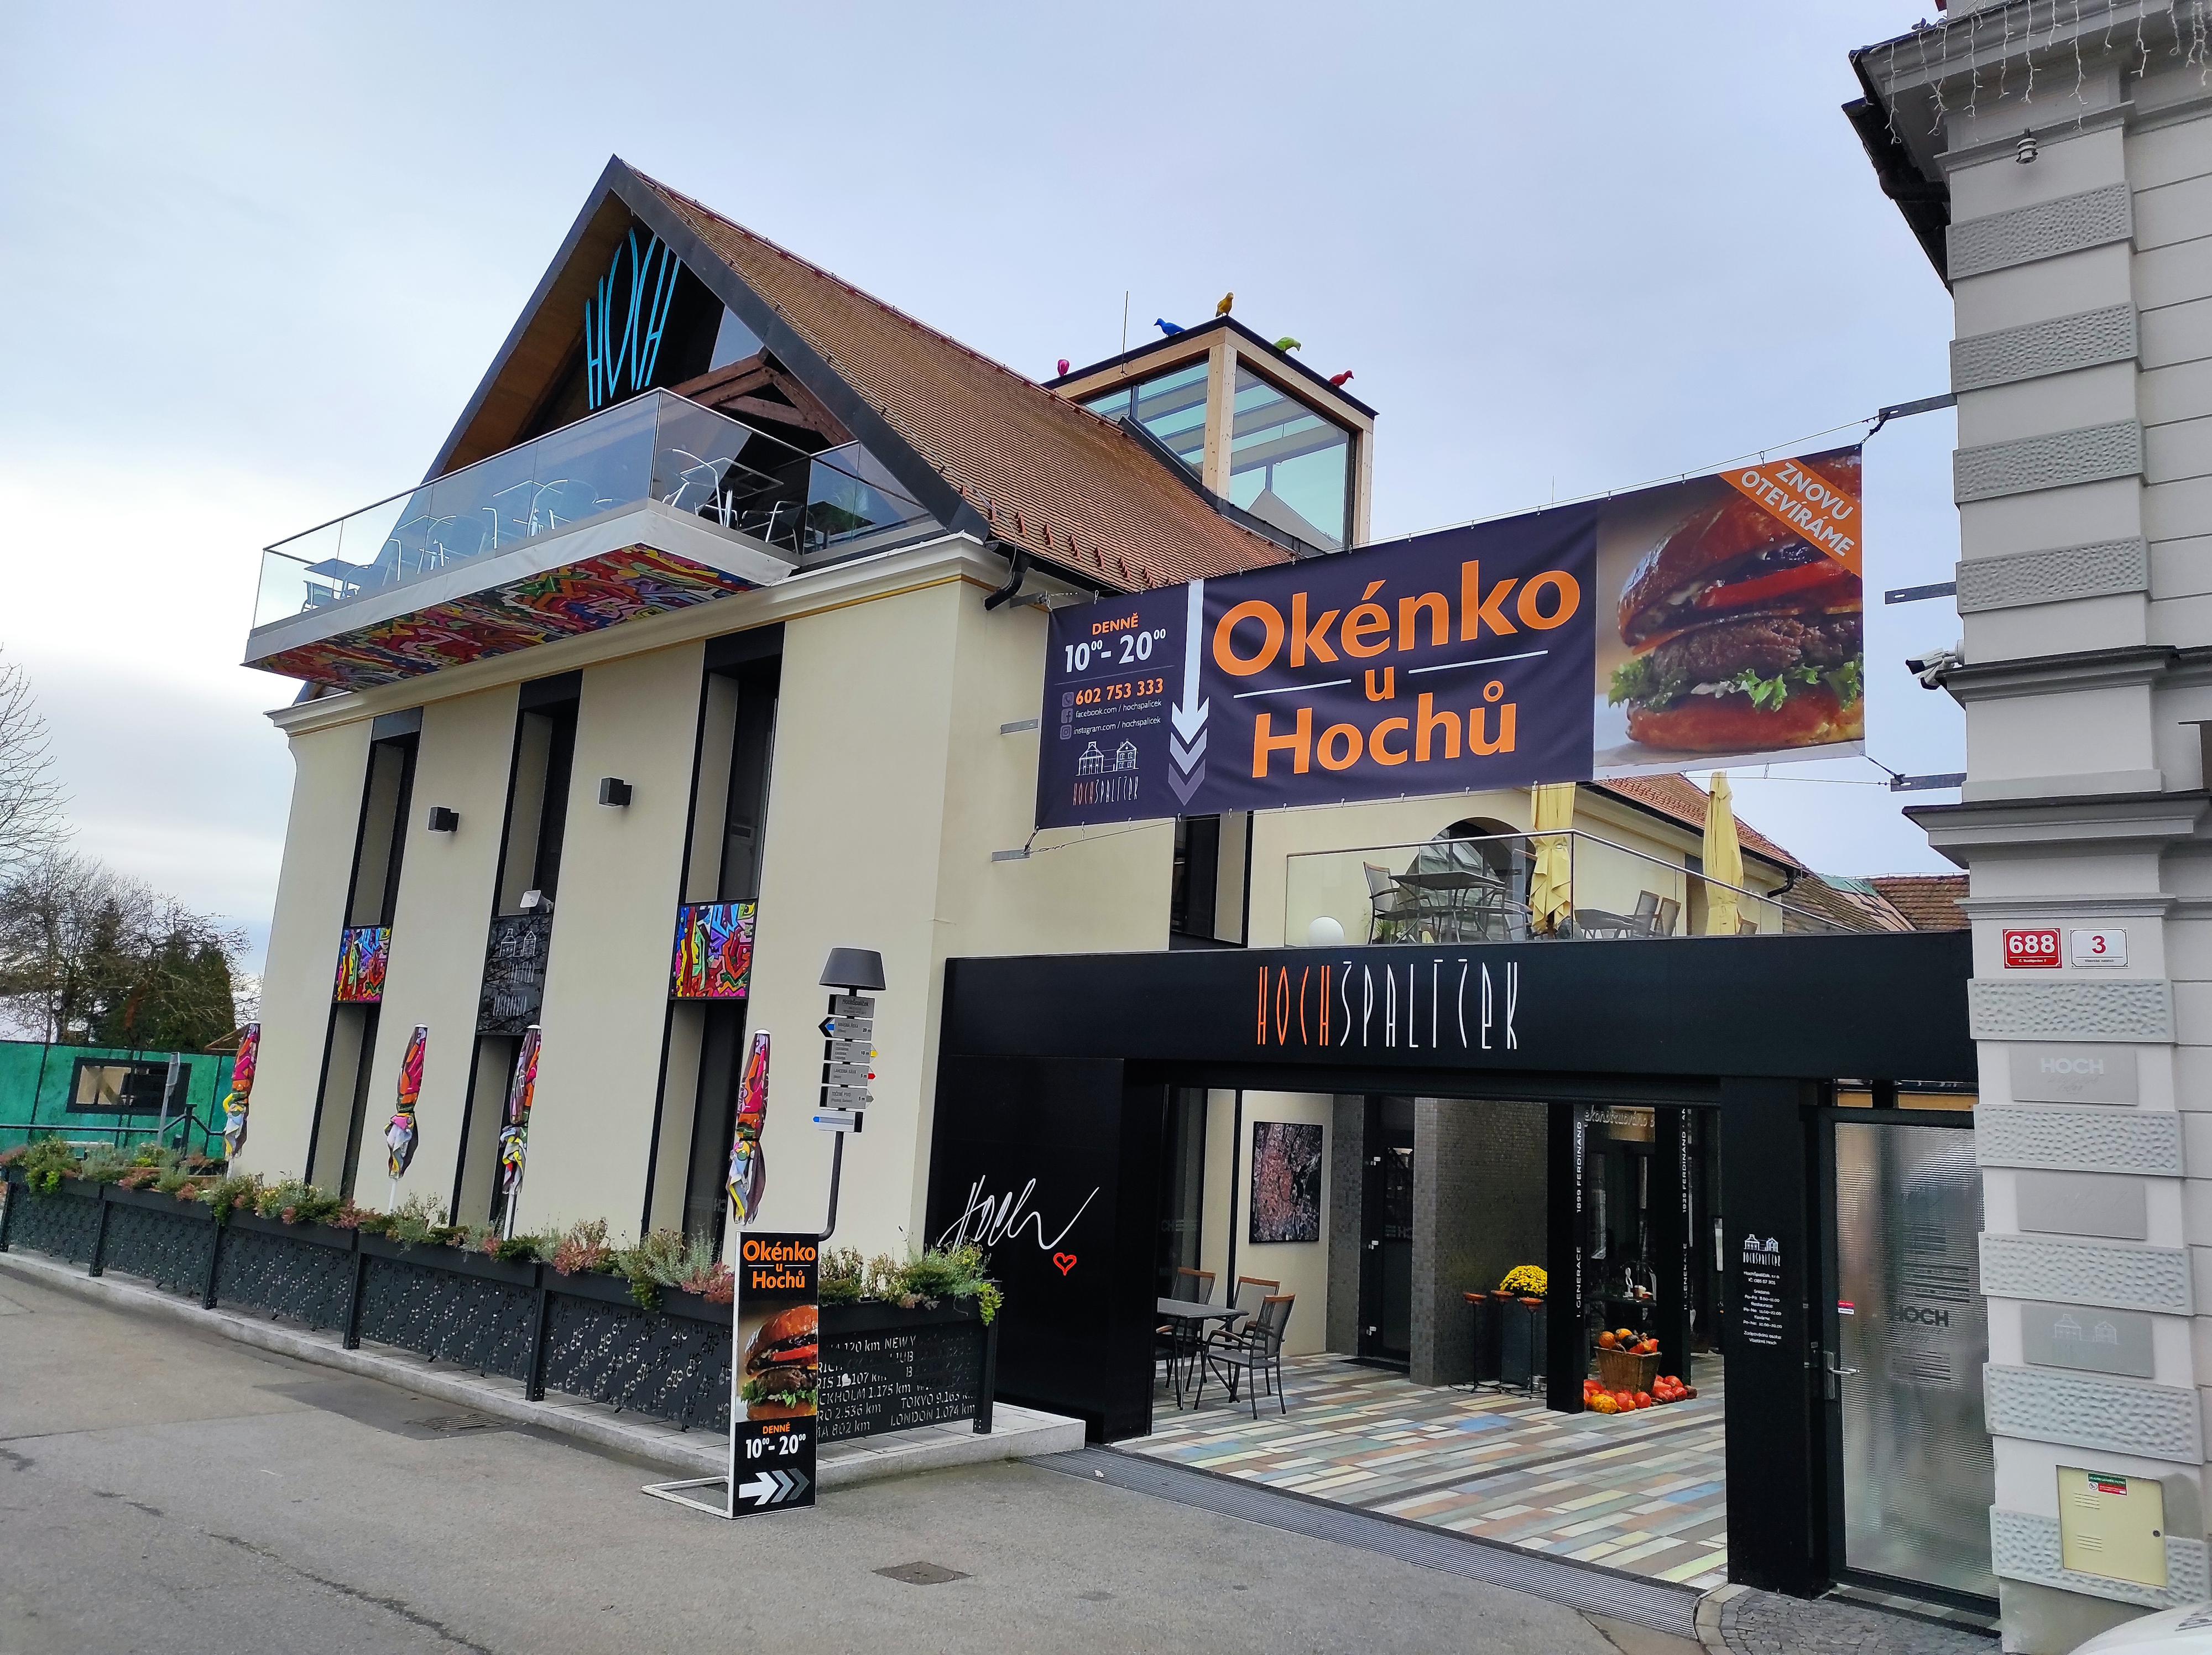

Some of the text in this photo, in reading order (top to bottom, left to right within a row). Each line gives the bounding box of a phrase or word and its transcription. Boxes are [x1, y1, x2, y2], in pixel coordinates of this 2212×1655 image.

[1775, 462, 1854, 520] ZNOVU
[1742, 471, 1855, 557] OTEVÍRÁME
[1092, 612, 1139, 635] DENNĚ
[1213, 560, 1580, 676] Okénko
[1076, 678, 1164, 706] 602 753 333
[1365, 666, 1395, 702] u
[1076, 706, 1117, 718] facebook.com
[1073, 723, 1116, 735] instagram.com
[1251, 680, 1517, 778] Hochů
[2009, 934, 2056, 954] 688
[2091, 935, 2106, 954] 3
[2041, 1057, 2104, 1074] HOCH
[743, 1240, 816, 1261] Okénko
[776, 1264, 782, 1272] u
[753, 1270, 805, 1288] Hochů
[864, 1339, 880, 1352] km
[896, 1382, 911, 1395] km
[865, 1402, 881, 1414] km
[901, 1393, 933, 1409] TOKYO
[890, 1409, 933, 1426] LONDON
[961, 1403, 975, 1415] km
[832, 1422, 852, 1436] 802
[854, 1419, 870, 1432] km
